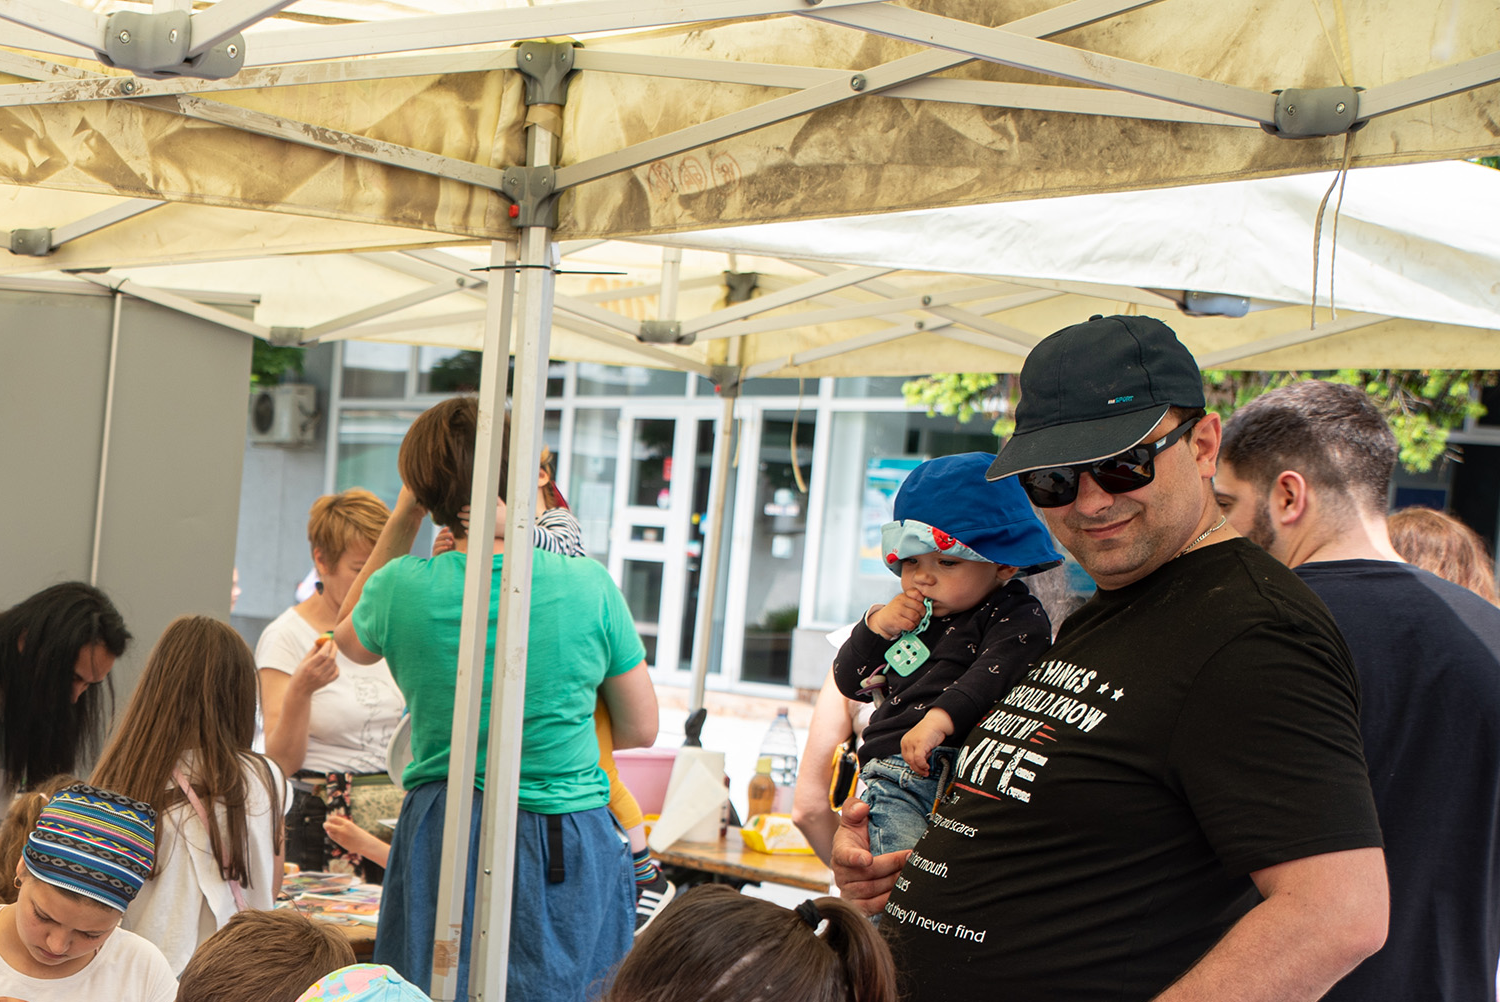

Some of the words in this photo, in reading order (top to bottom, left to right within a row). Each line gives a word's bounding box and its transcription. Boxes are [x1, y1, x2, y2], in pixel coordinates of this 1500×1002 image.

[979, 709, 1027, 737] ABOUT
[1013, 718, 1044, 740] MY
[1043, 695, 1108, 733] KNOW
[949, 820, 979, 838] scares
[918, 858, 949, 879] mouth.
[915, 915, 953, 935] never
[954, 924, 987, 944] find
